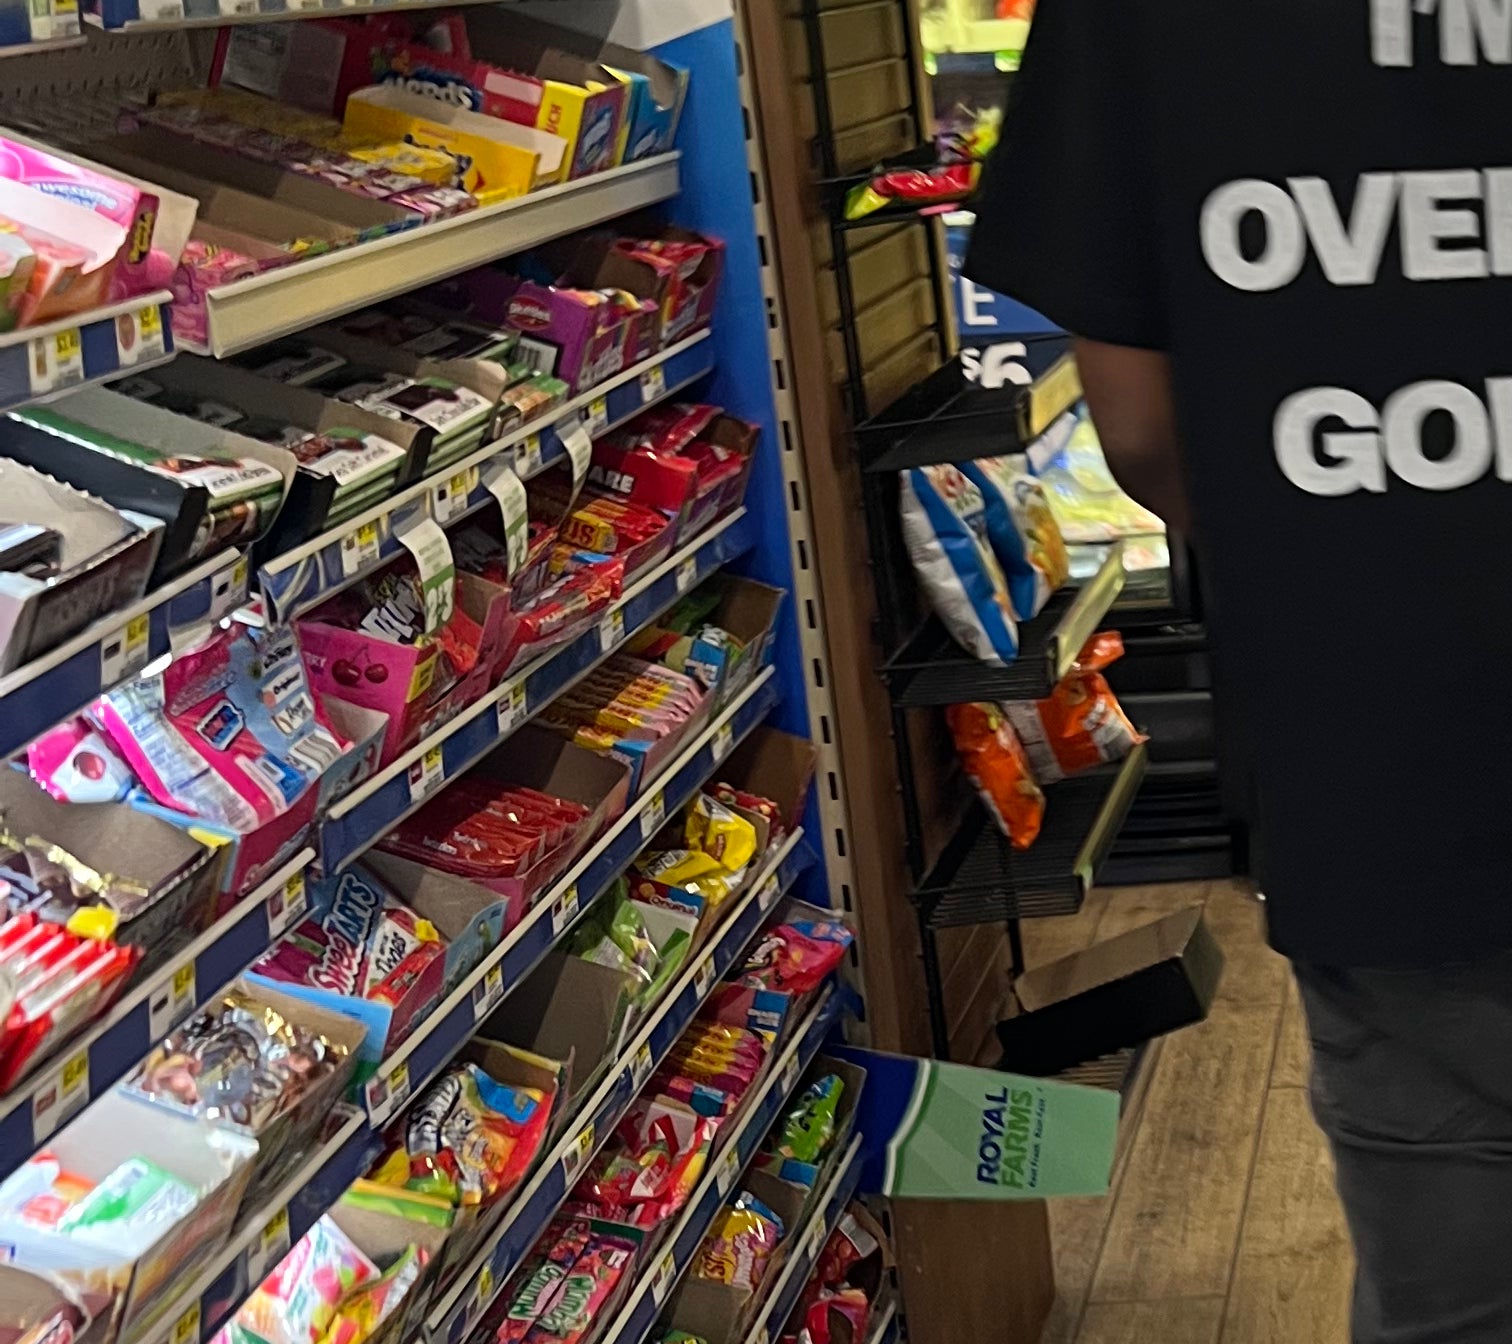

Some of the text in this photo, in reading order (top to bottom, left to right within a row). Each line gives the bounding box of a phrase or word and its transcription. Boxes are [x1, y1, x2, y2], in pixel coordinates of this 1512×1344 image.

[587, 464, 635, 494] ARE
[976, 1085, 1009, 1185] ROYAL
[1002, 1088, 1034, 1189] FARMS
